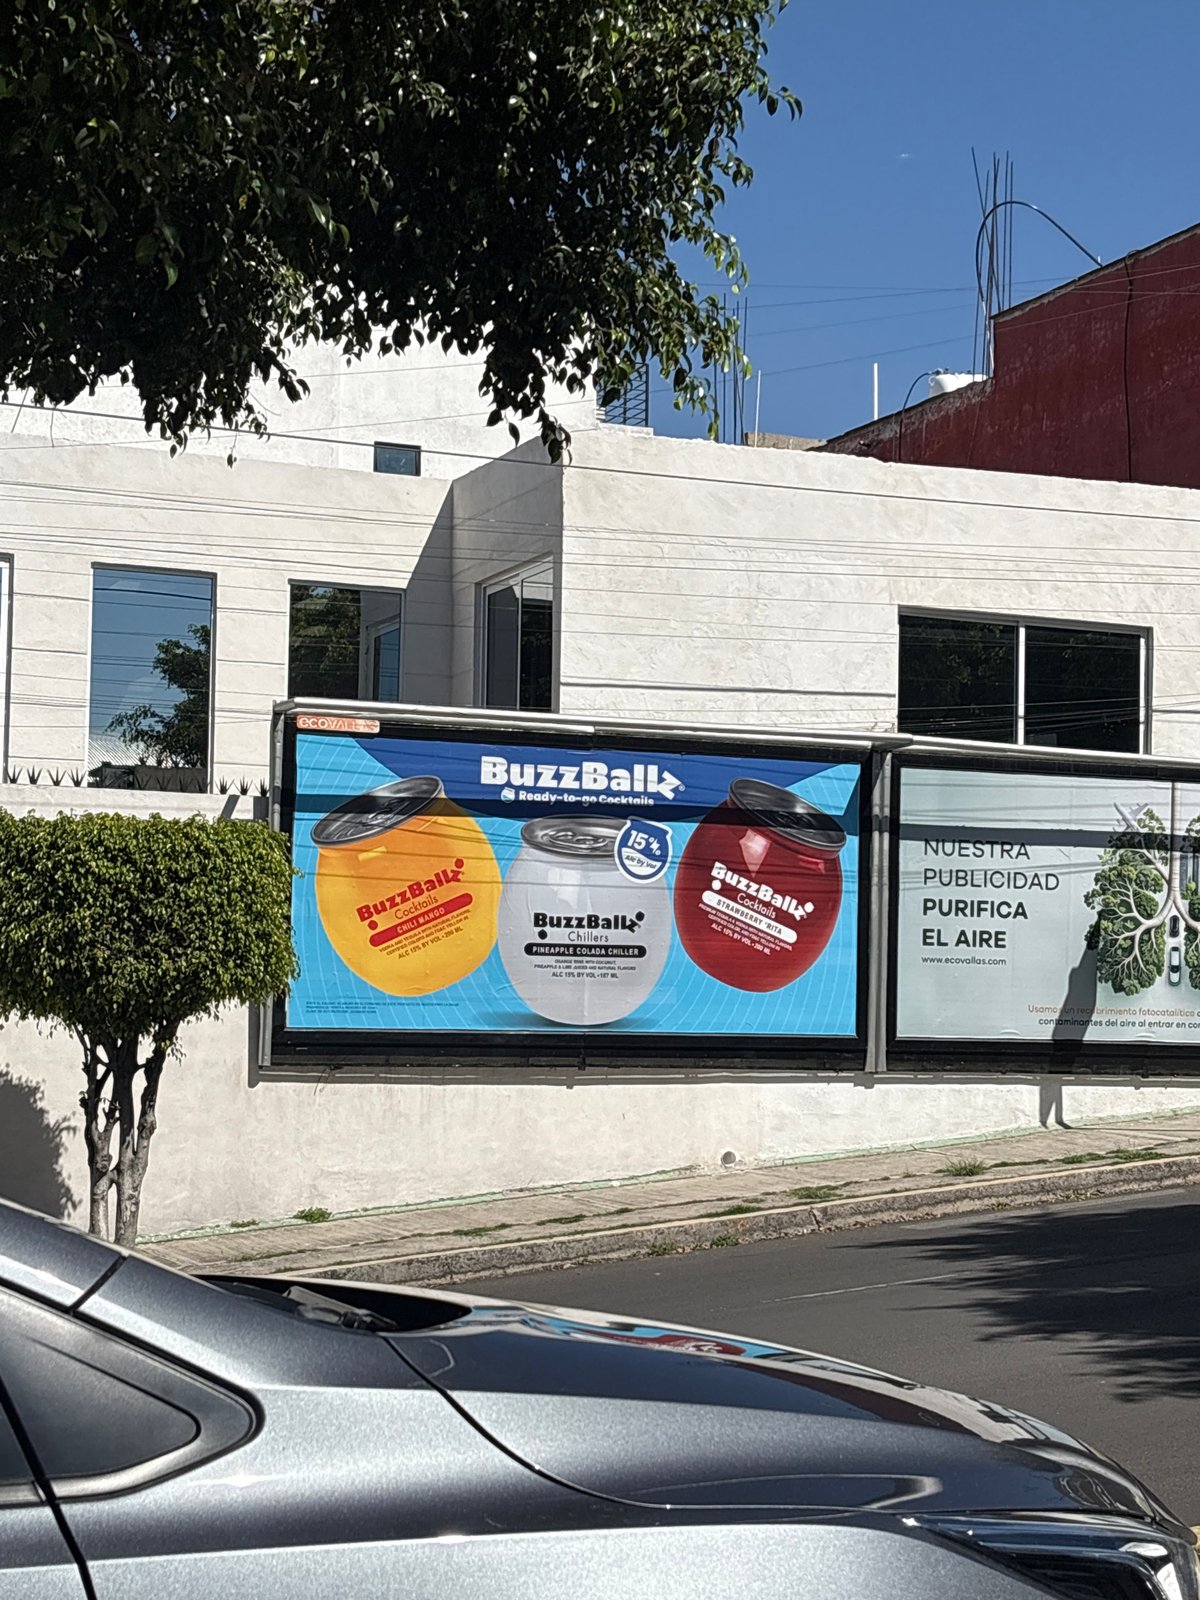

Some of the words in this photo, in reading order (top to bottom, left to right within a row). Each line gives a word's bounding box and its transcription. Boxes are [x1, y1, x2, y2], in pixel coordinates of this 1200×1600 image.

[480, 755, 684, 800] BuzzBallz
[519, 791, 597, 806] Ready-to-go
[599, 795, 655, 806] Cocktails
[628, 830, 661, 855] 15%
[924, 838, 1030, 860] NUESTRA
[924, 868, 1060, 890] PUBLICIDAD
[356, 869, 462, 922] BuzzBallz
[711, 861, 806, 921] BuzzBallz
[394, 894, 438, 920] Cocktails
[717, 899, 763, 926] STRAWBERRY
[737, 893, 776, 918] Cocktails
[922, 898, 1028, 920] PURIFICA
[397, 920, 417, 933] CHILI
[418, 907, 445, 924] MANGO
[534, 912, 640, 934] BuzzBallz
[398, 950, 410, 959] ALC
[430, 936, 442, 944] VOL
[568, 931, 609, 943] Chillers
[922, 928, 948, 947] EL
[955, 930, 1006, 948] AIRE
[532, 946, 573, 954] PINEAPPLE
[922, 955, 1006, 966] www.ecovallas.com
[1105, 1018, 1118, 1027] del
[1120, 1019, 1136, 1027] aire
[1138, 1019, 1146, 1027] al
